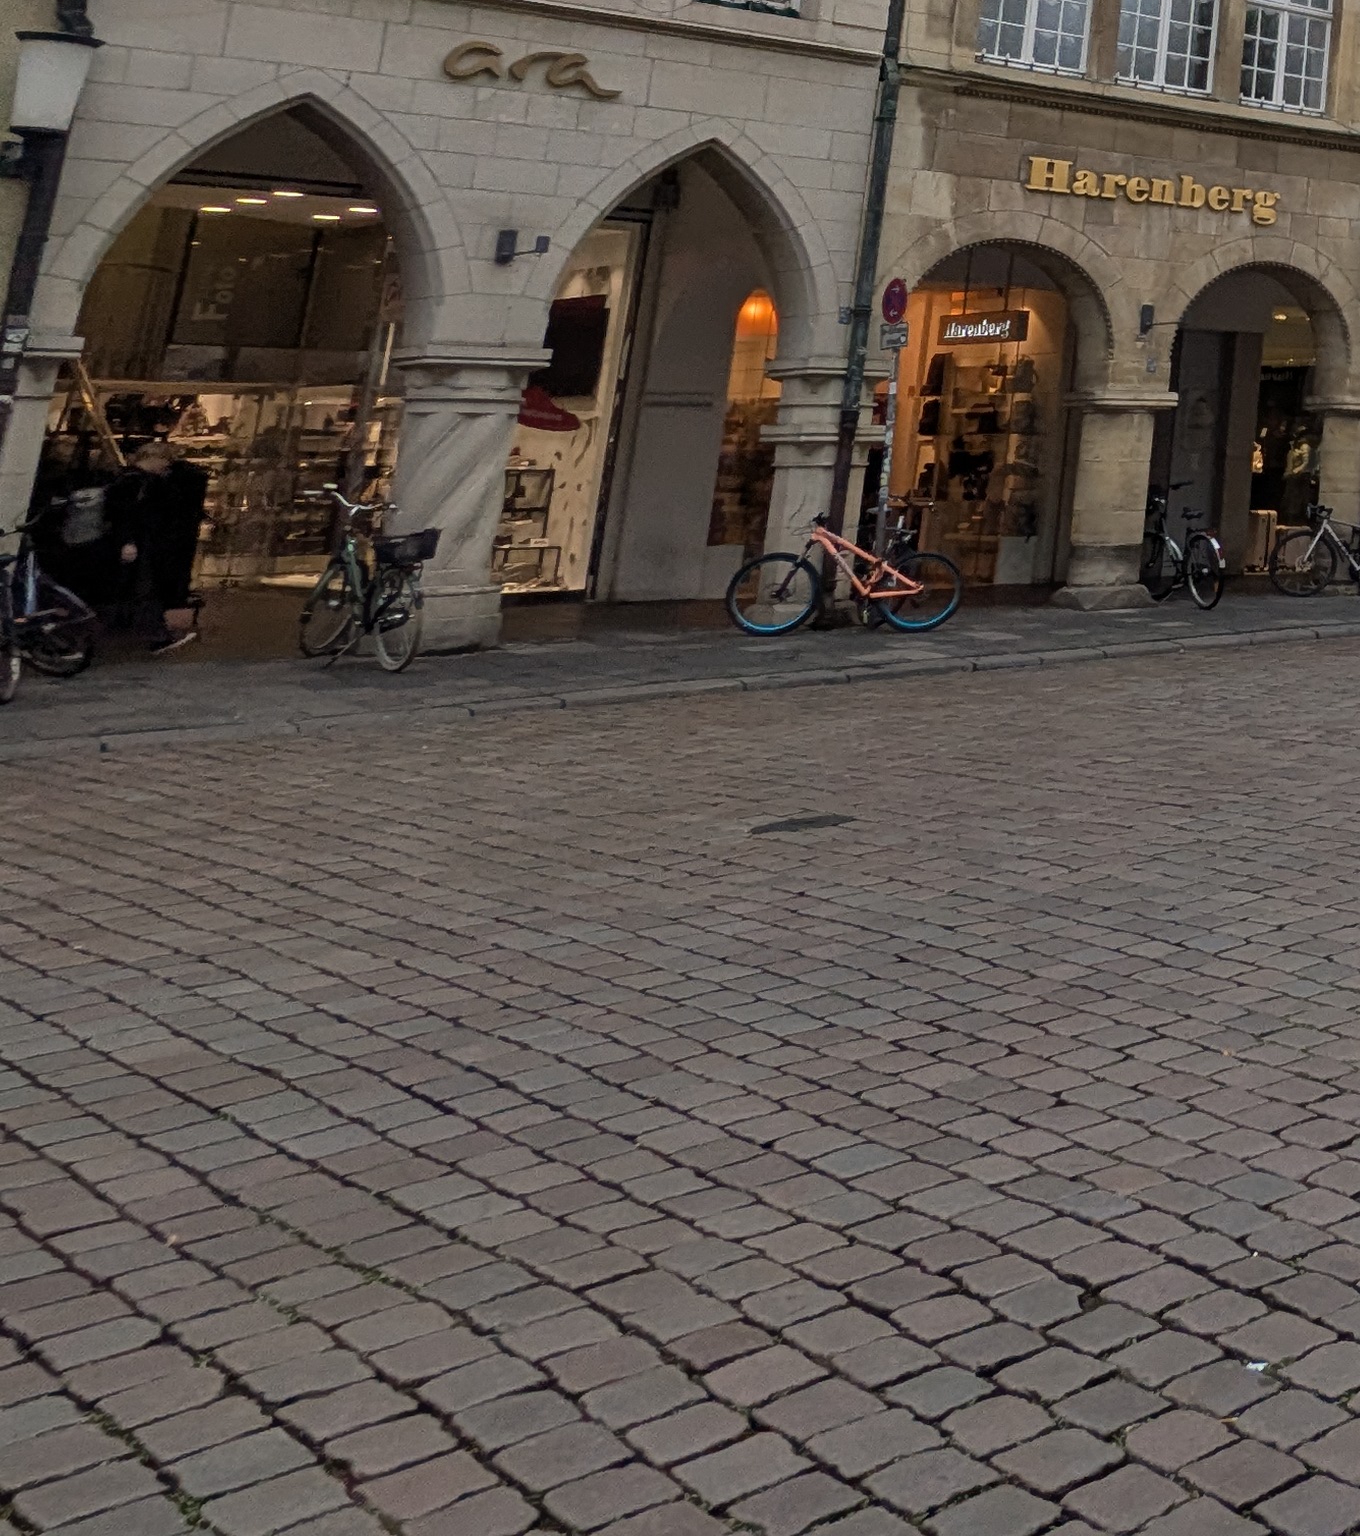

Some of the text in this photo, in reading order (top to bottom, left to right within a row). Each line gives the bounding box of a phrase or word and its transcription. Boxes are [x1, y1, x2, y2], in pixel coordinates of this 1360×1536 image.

[443, 40, 623, 99] ara
[1025, 155, 1282, 225] Harenberg
[943, 318, 1011, 339] Harenberg
